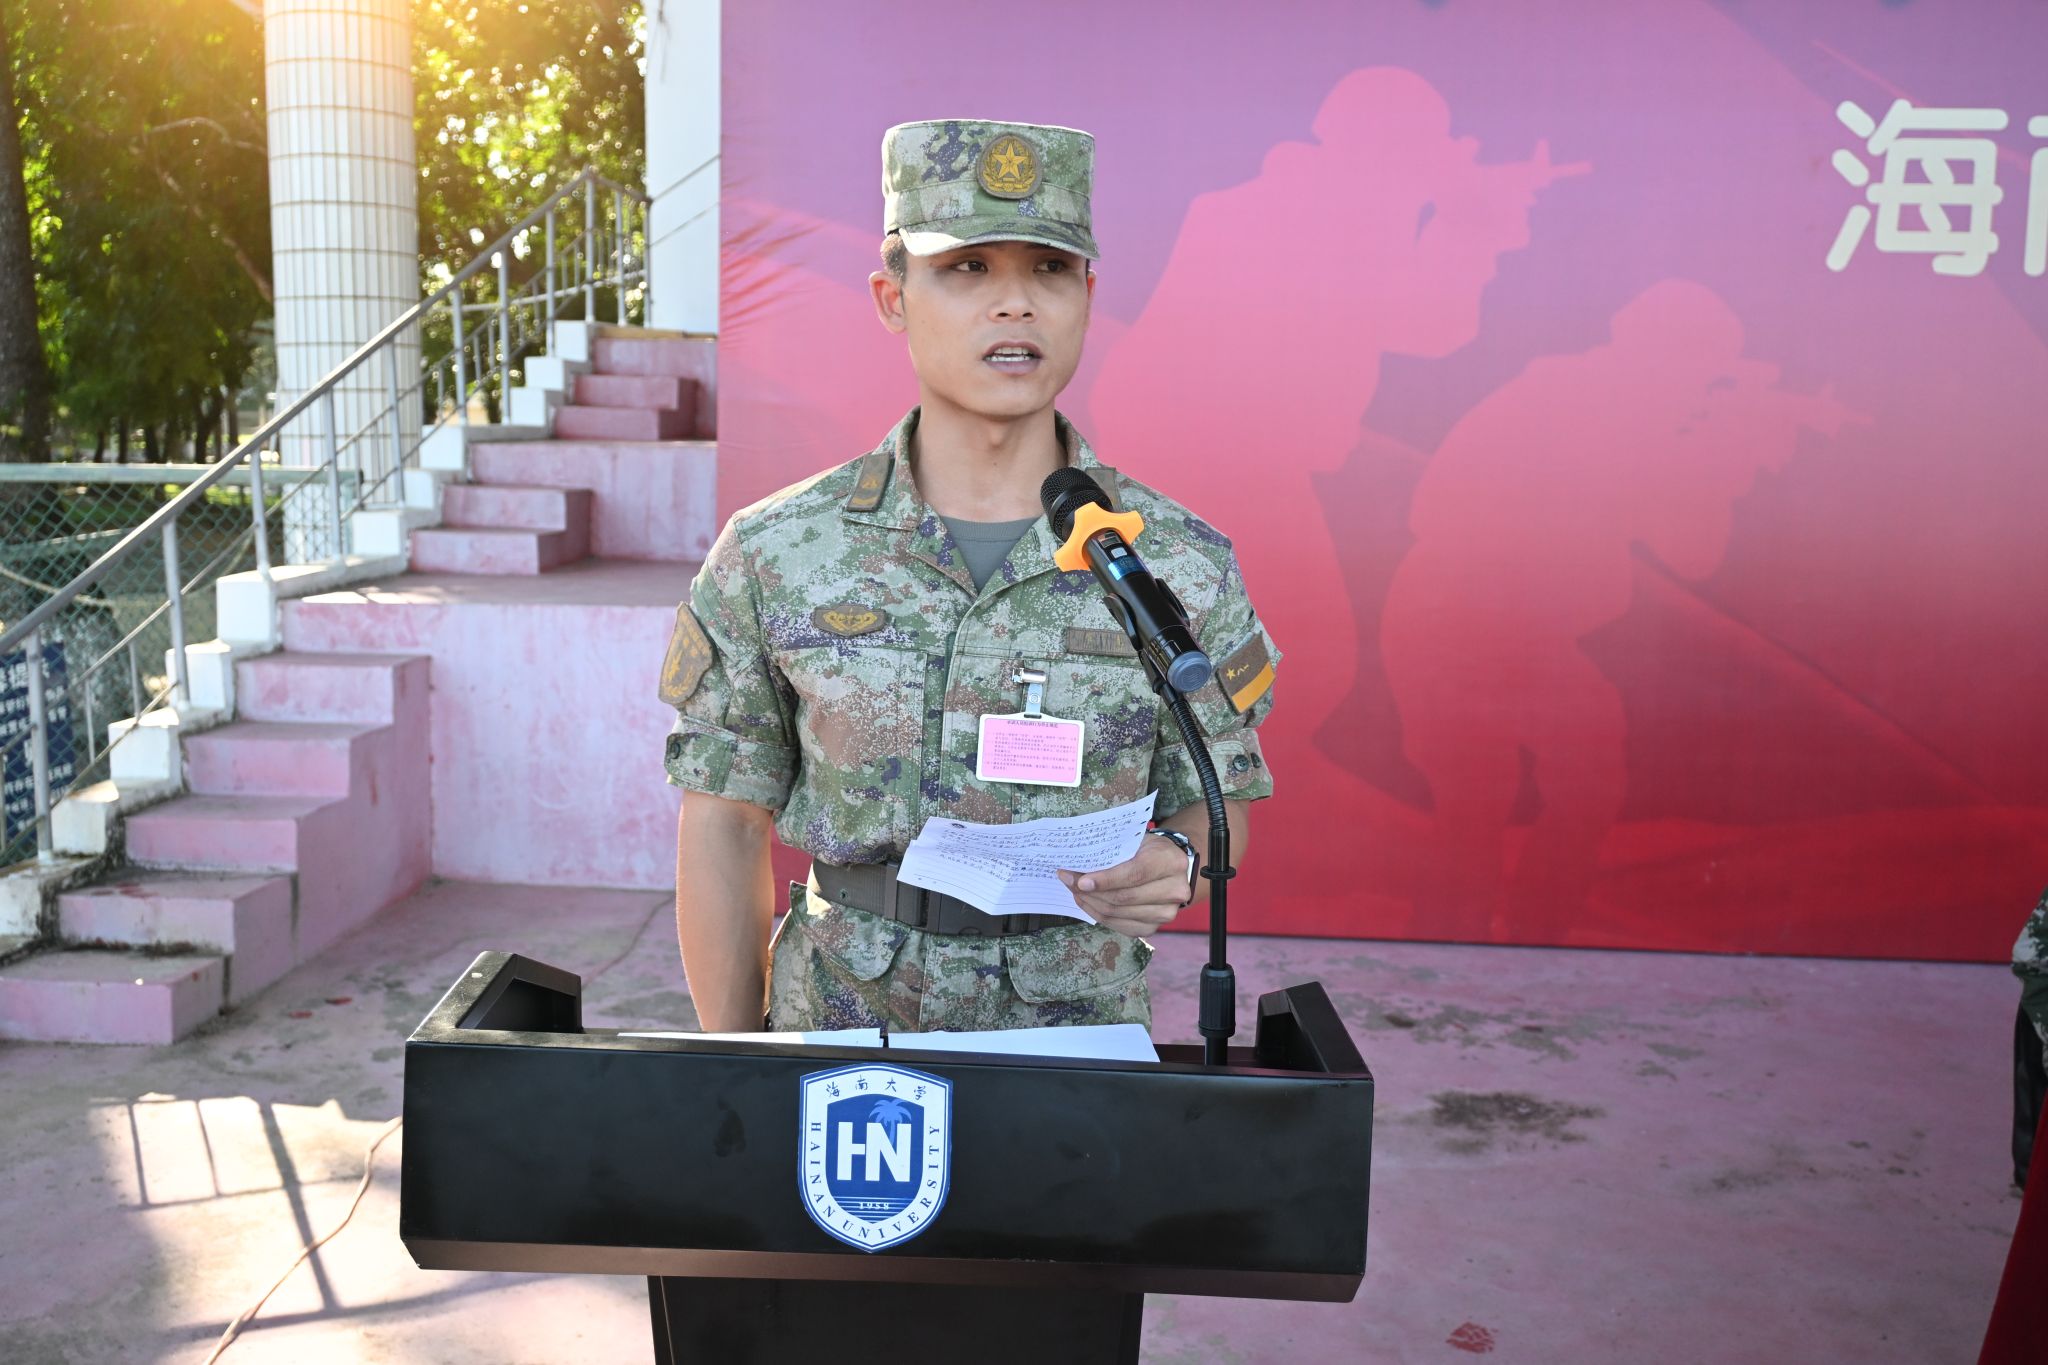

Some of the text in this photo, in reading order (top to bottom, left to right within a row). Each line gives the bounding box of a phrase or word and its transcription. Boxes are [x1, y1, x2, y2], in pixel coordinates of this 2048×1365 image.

[1826, 98, 2048, 277] 海
[826, 1074, 927, 1101] 海南大学
[810, 1122, 940, 1239] HAINAN UNIVERSITY
[837, 1121, 912, 1183] HN
[859, 1202, 889, 1210] 1958
